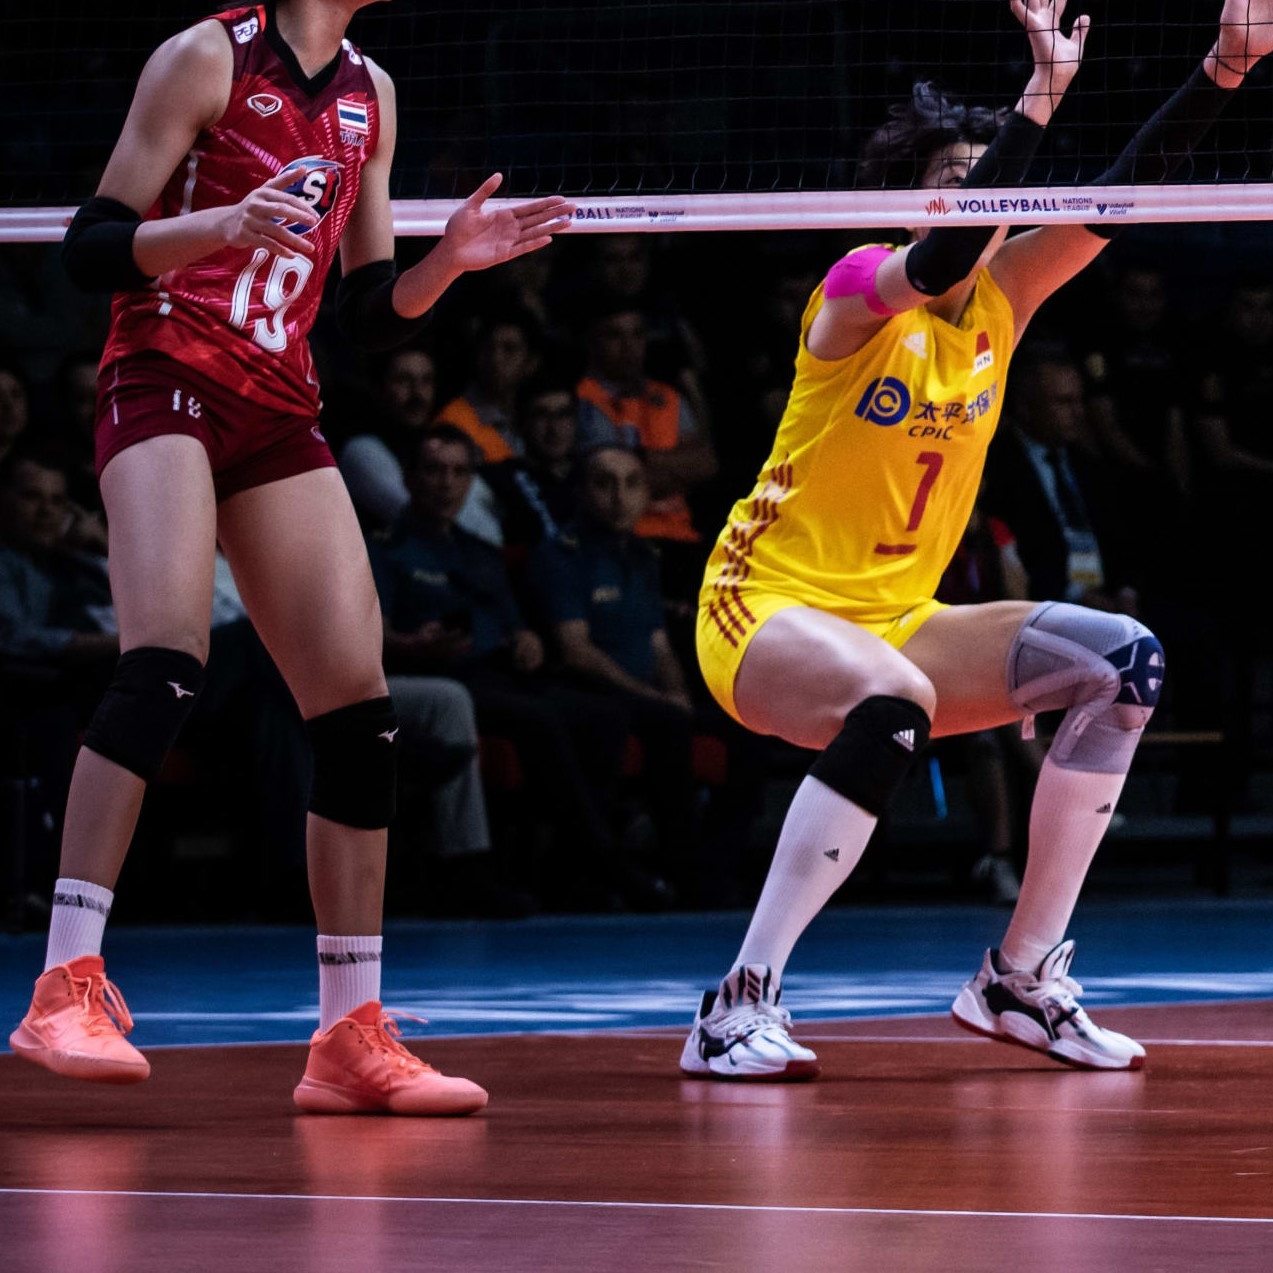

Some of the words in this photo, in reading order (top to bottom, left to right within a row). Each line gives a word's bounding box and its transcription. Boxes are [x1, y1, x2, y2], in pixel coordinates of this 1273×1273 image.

[957, 199, 1060, 213] VOLLEYBALL
[1062, 197, 1093, 205] NATIONS
[229, 248, 314, 353] 19
[908, 425, 954, 441] CPIC
